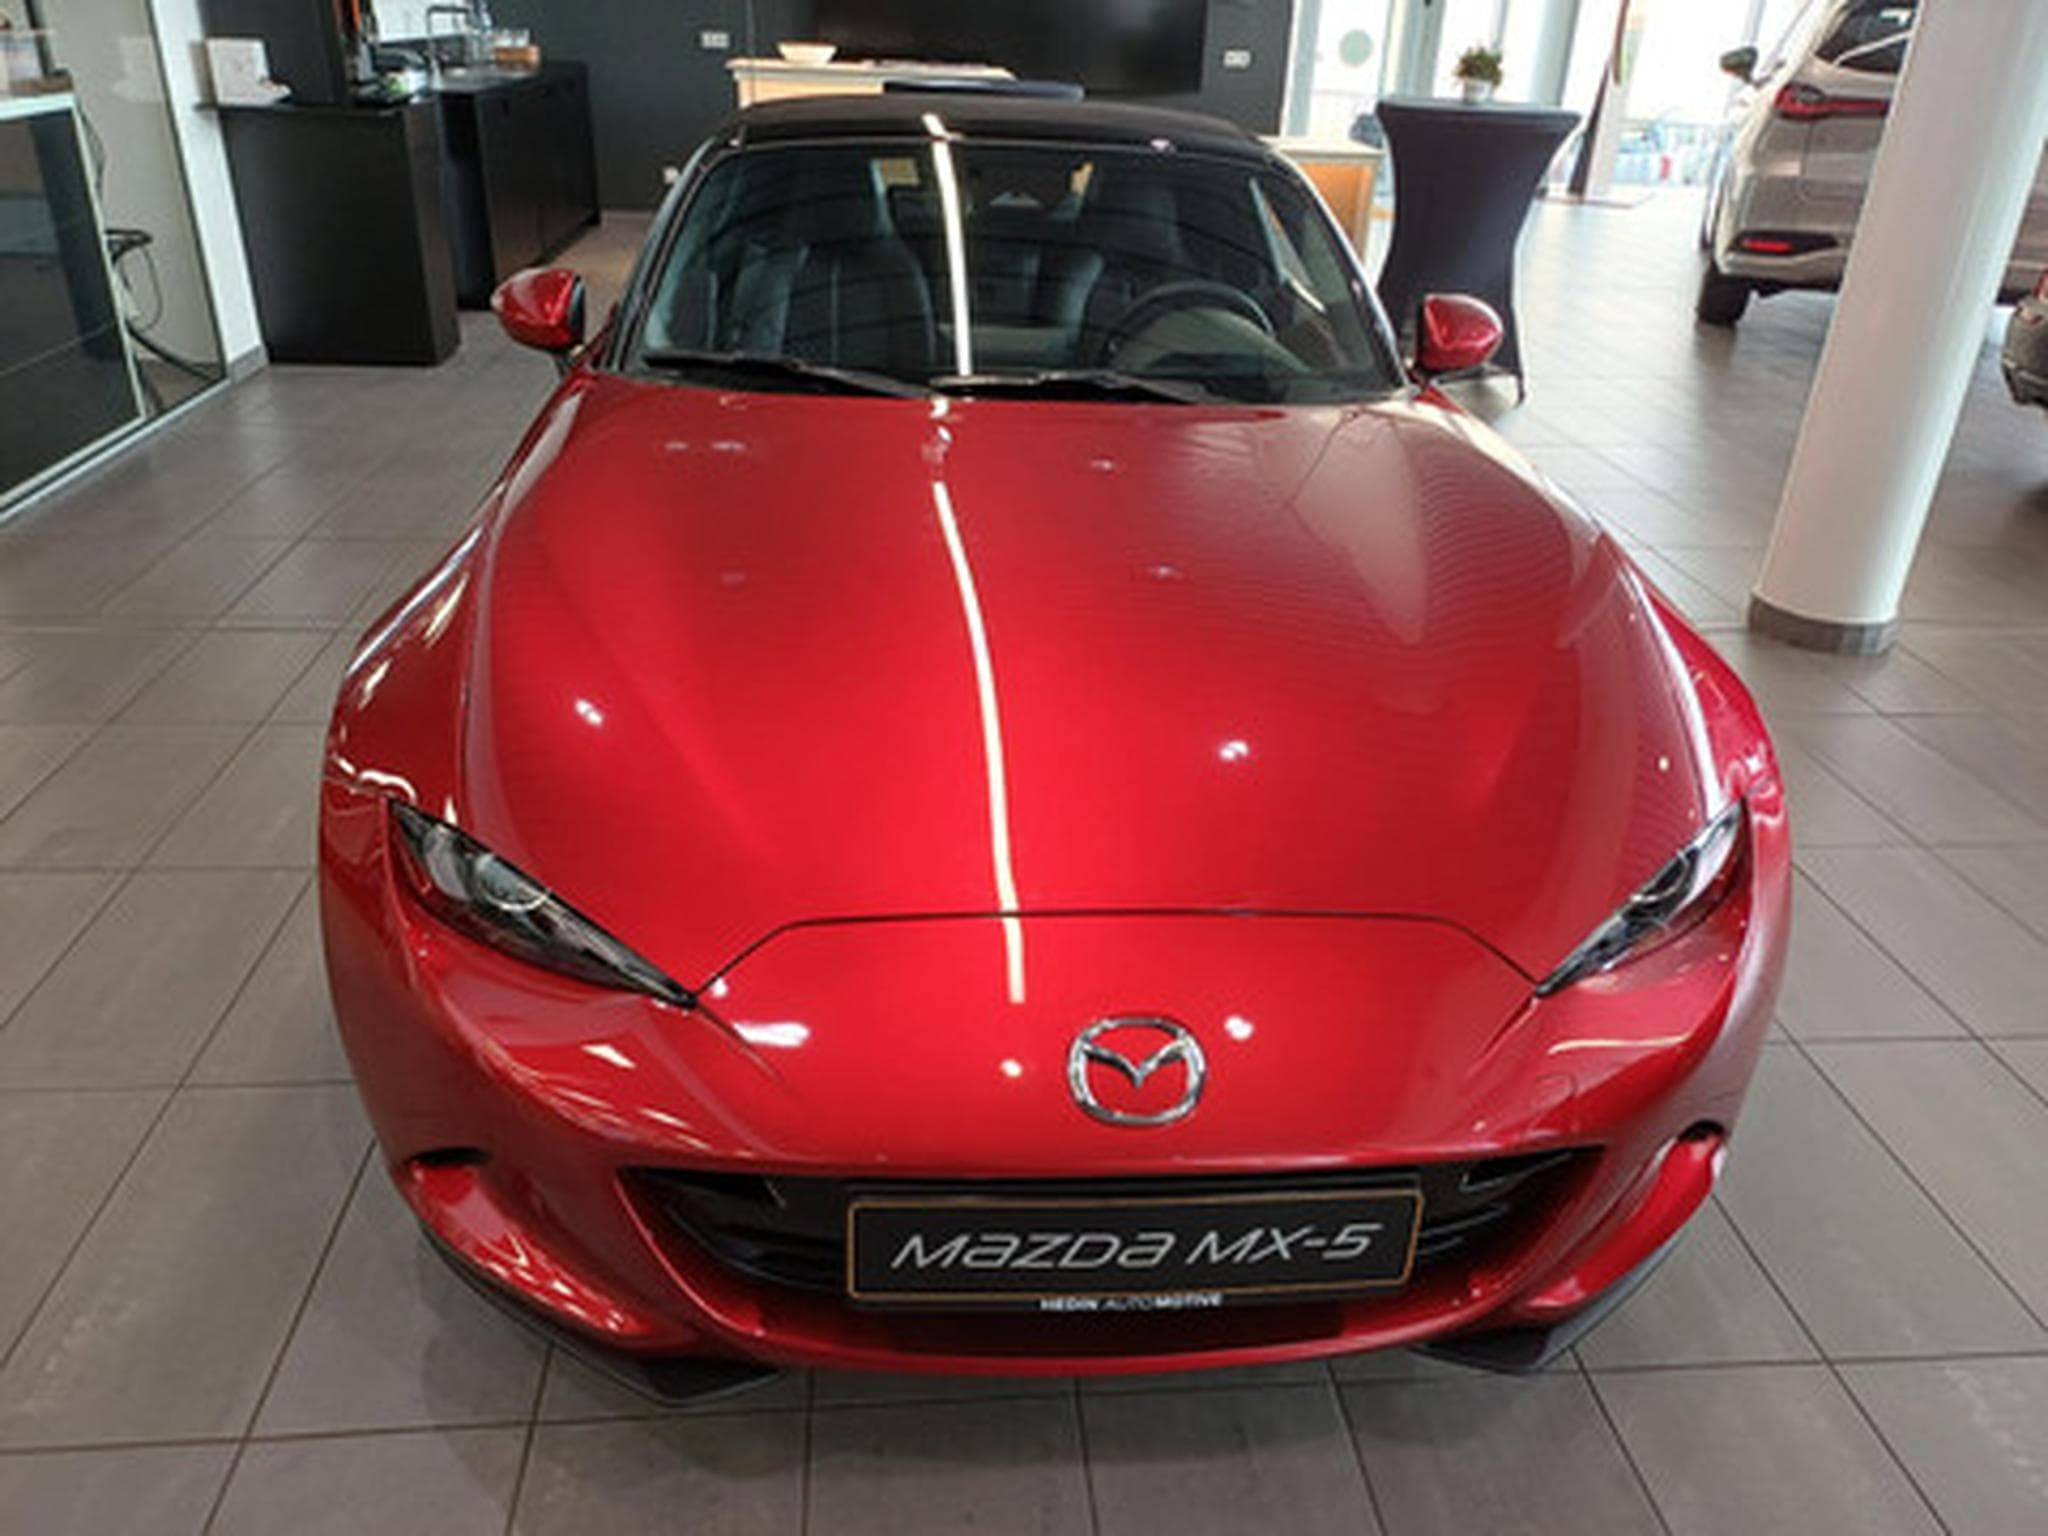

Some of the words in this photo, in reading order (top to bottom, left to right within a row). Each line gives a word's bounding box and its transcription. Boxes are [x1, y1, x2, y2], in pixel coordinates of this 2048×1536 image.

[1185, 1223, 1383, 1265] MX-5
[1040, 1297, 1098, 1310] HEDIN
[1103, 1292, 1222, 1310] AUTOMOTIVE
